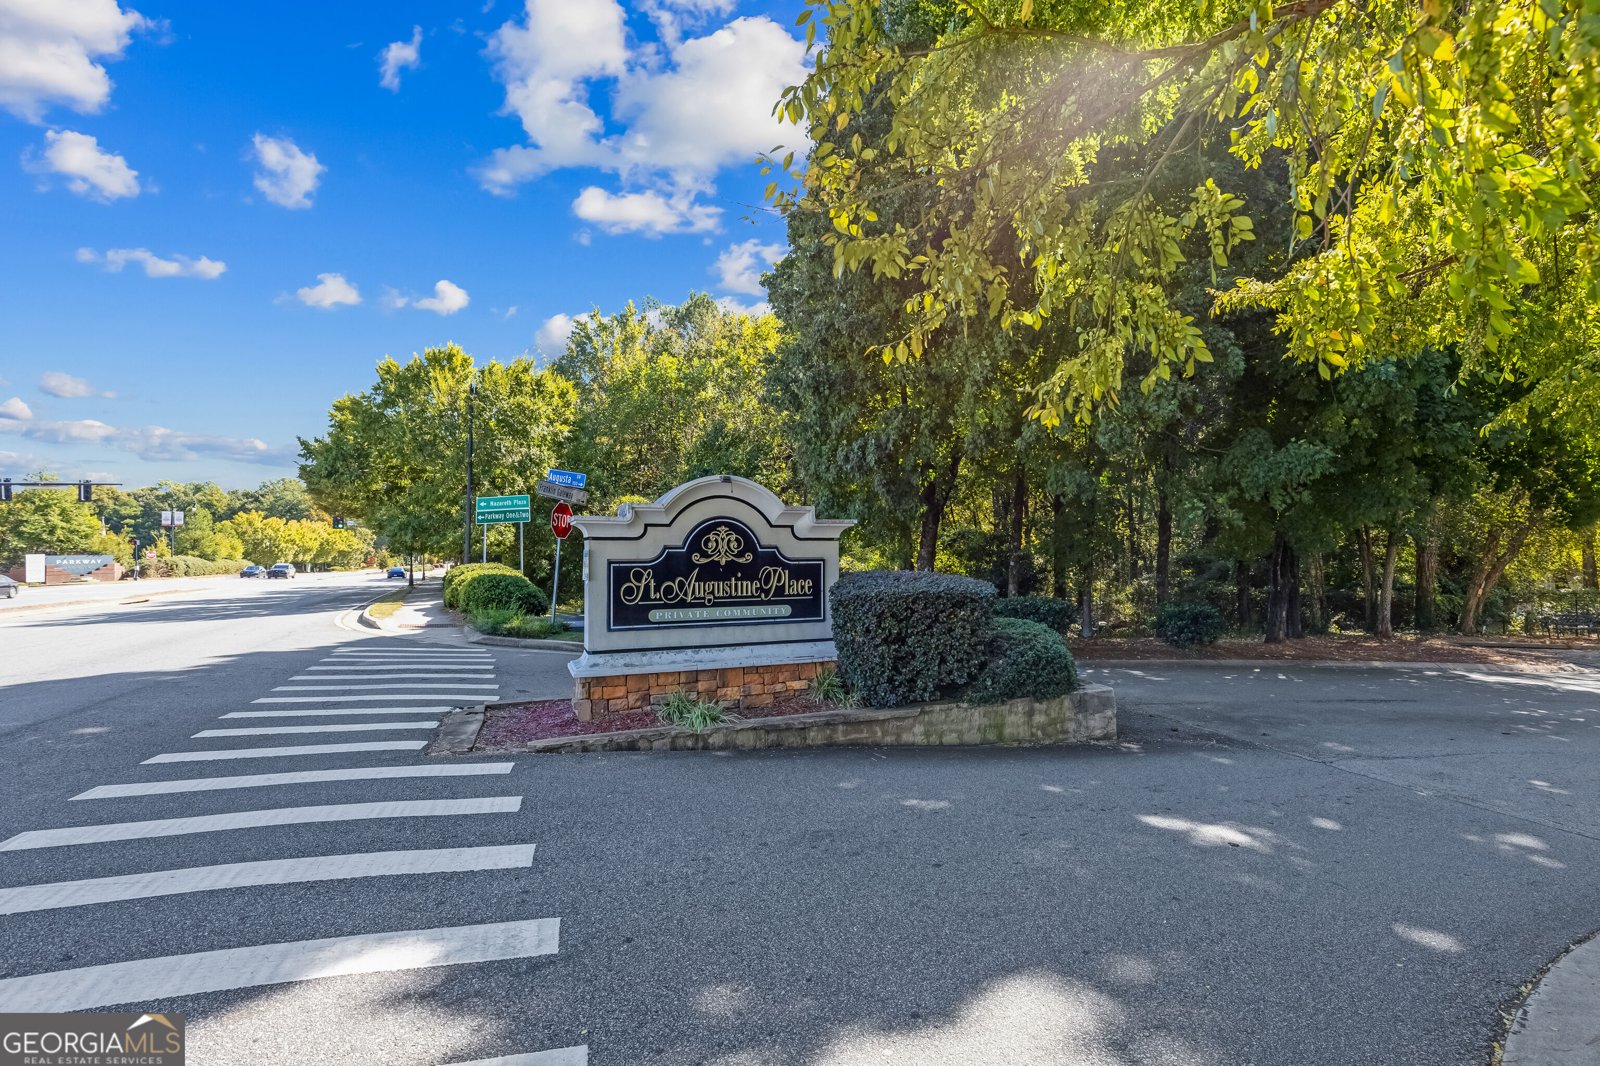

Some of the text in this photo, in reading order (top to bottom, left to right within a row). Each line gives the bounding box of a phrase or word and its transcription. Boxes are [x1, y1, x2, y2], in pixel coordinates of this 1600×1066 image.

[549, 473, 572, 485] Augusta
[484, 512, 505, 520] Parkway
[620, 566, 813, 606] St. Augustine Place
[656, 607, 787, 620] PRIVATE COMMUNITY
